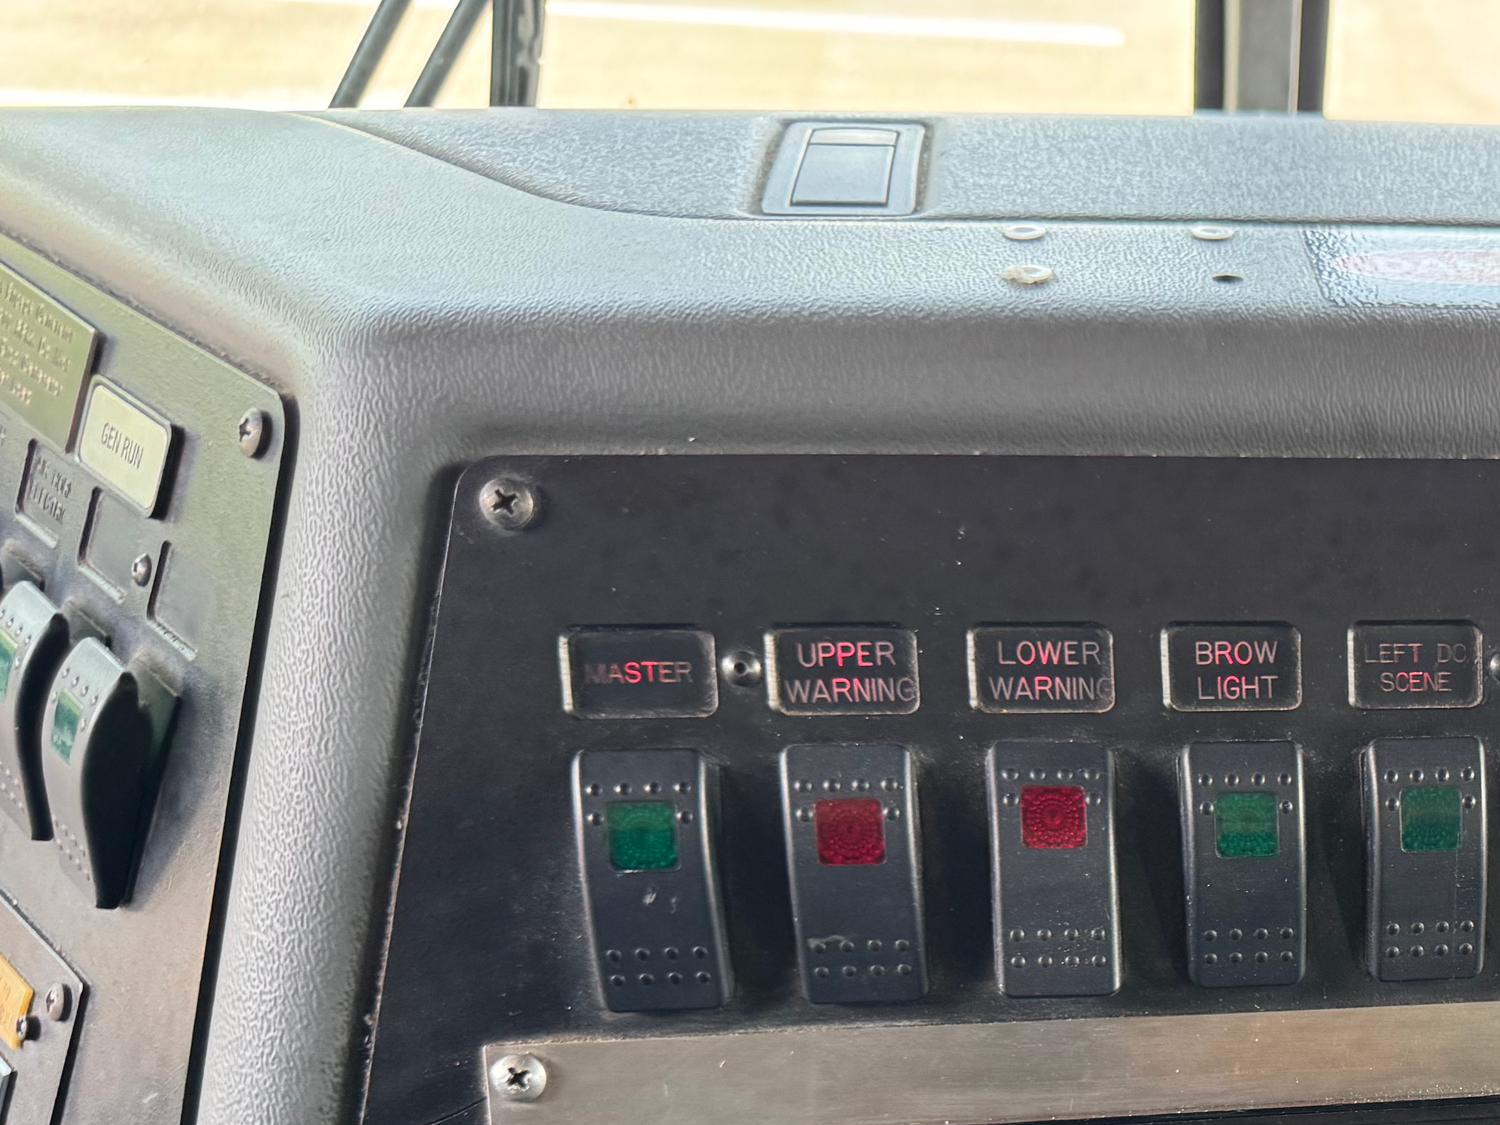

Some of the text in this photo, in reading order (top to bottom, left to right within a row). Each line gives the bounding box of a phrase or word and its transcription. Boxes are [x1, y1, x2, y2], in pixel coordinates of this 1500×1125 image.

[101, 422, 144, 470] GEN RUN
[797, 641, 896, 668] UPPER
[997, 640, 1101, 666] LOWER
[1195, 640, 1279, 666] BROW
[1364, 643, 1468, 664] LEFT DC
[585, 660, 693, 684] MASTER
[1379, 671, 1452, 693] SCENE
[785, 676, 917, 704] WARNING
[988, 675, 1114, 701] WARNING
[1198, 675, 1279, 700] LIGHT
